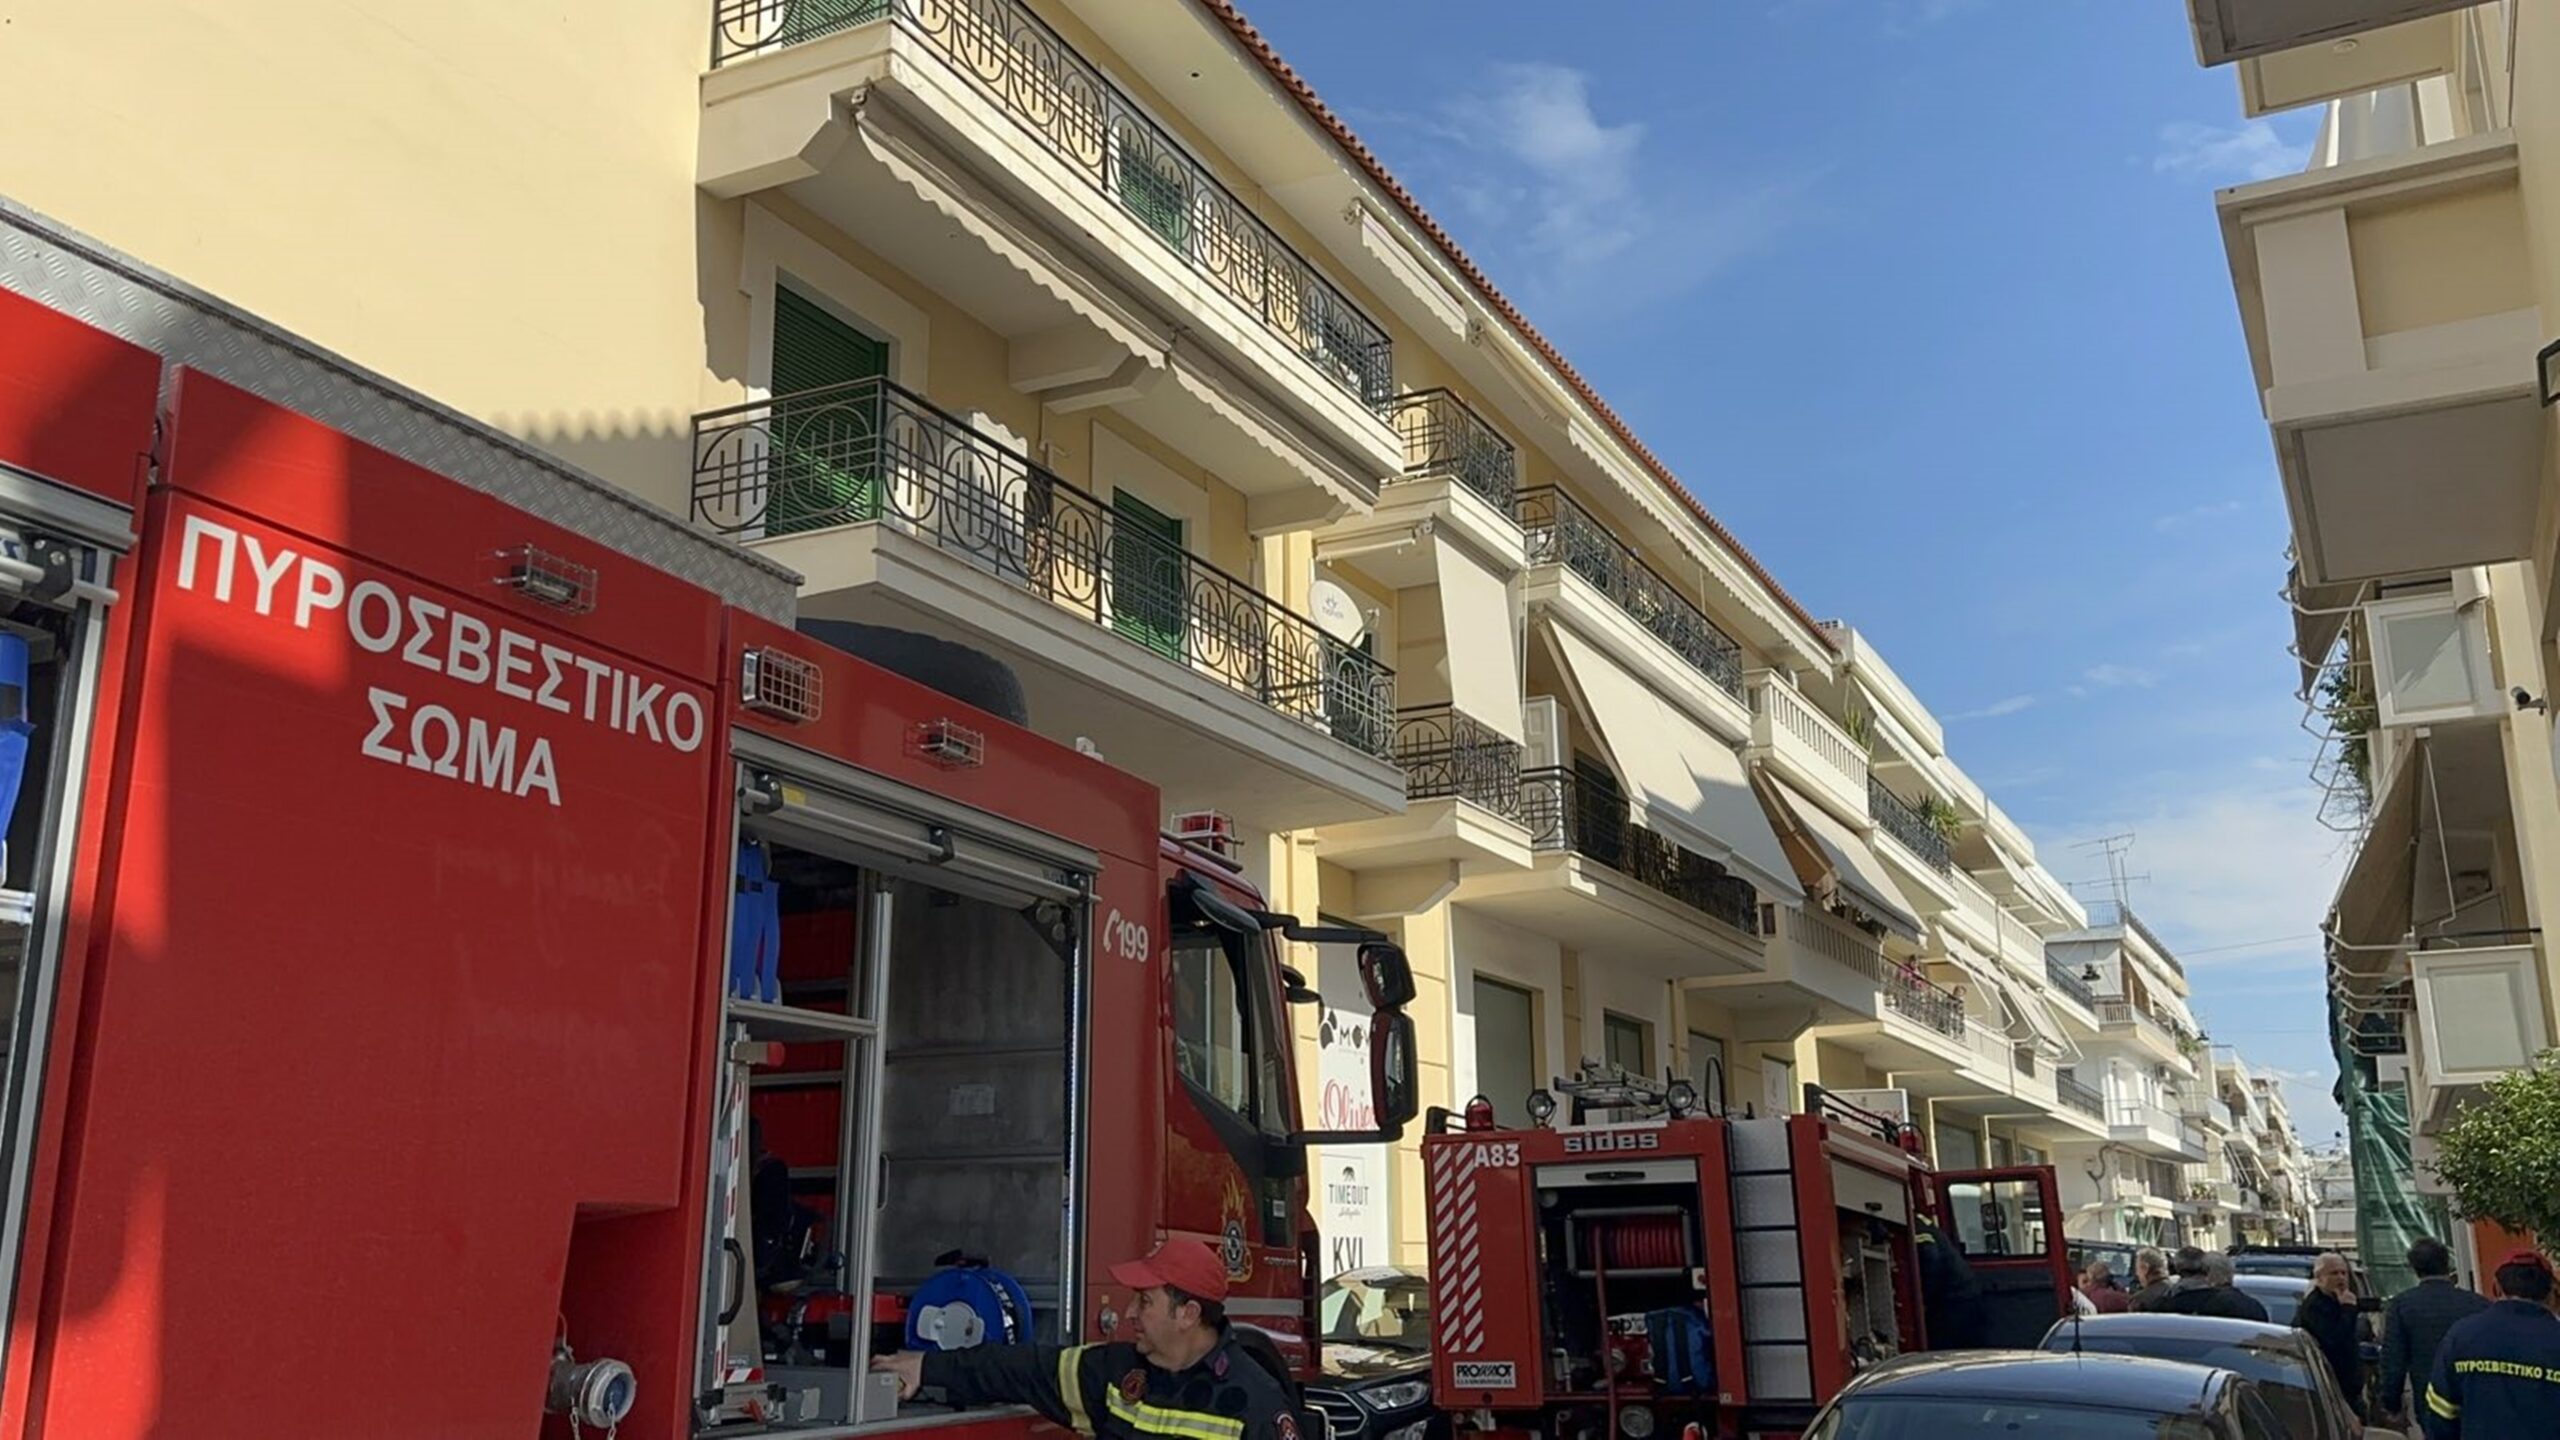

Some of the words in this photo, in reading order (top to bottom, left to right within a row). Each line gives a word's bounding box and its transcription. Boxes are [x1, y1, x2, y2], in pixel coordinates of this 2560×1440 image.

[177, 514, 704, 753] ΠΥΡΟΣΒΕΣΤΙΚΟ
[362, 687, 561, 806] ΣΩΜΑ
[1116, 920, 1148, 962] 199
[1565, 1132, 1658, 1152] sides
[1475, 1144, 1520, 1167] A83
[1328, 1184, 1369, 1205] TIMEOUT
[2455, 1361, 2543, 1379] ΠΥΡΟΣΒΕΣΤΙΚΟ
